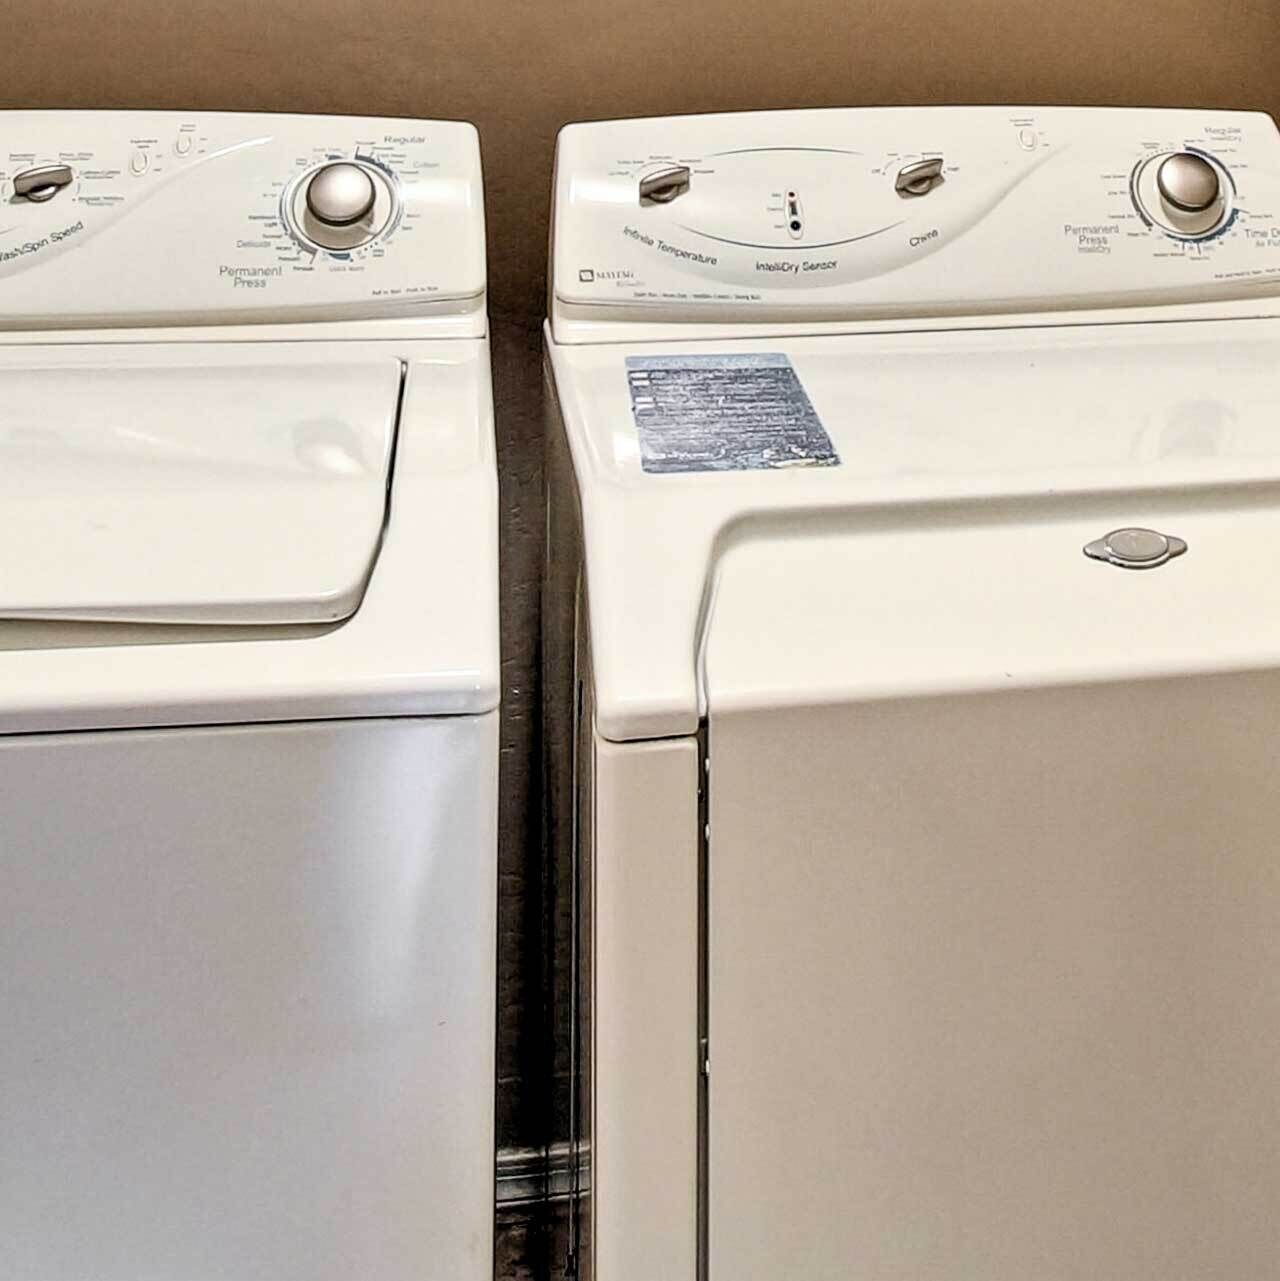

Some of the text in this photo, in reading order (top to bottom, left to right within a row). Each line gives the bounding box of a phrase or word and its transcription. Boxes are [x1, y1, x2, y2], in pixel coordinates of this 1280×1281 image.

[384, 136, 425, 146] Regular
[50, 221, 84, 243] Speed
[1064, 224, 1119, 235] Permanent
[1245, 228, 1268, 239] Time
[624, 225, 718, 266] Infinite Temperature
[1079, 235, 1108, 245] Press
[219, 265, 282, 277] Permanent
[756, 260, 838, 274] IntelliDry Sensor
[234, 277, 266, 288] Press
